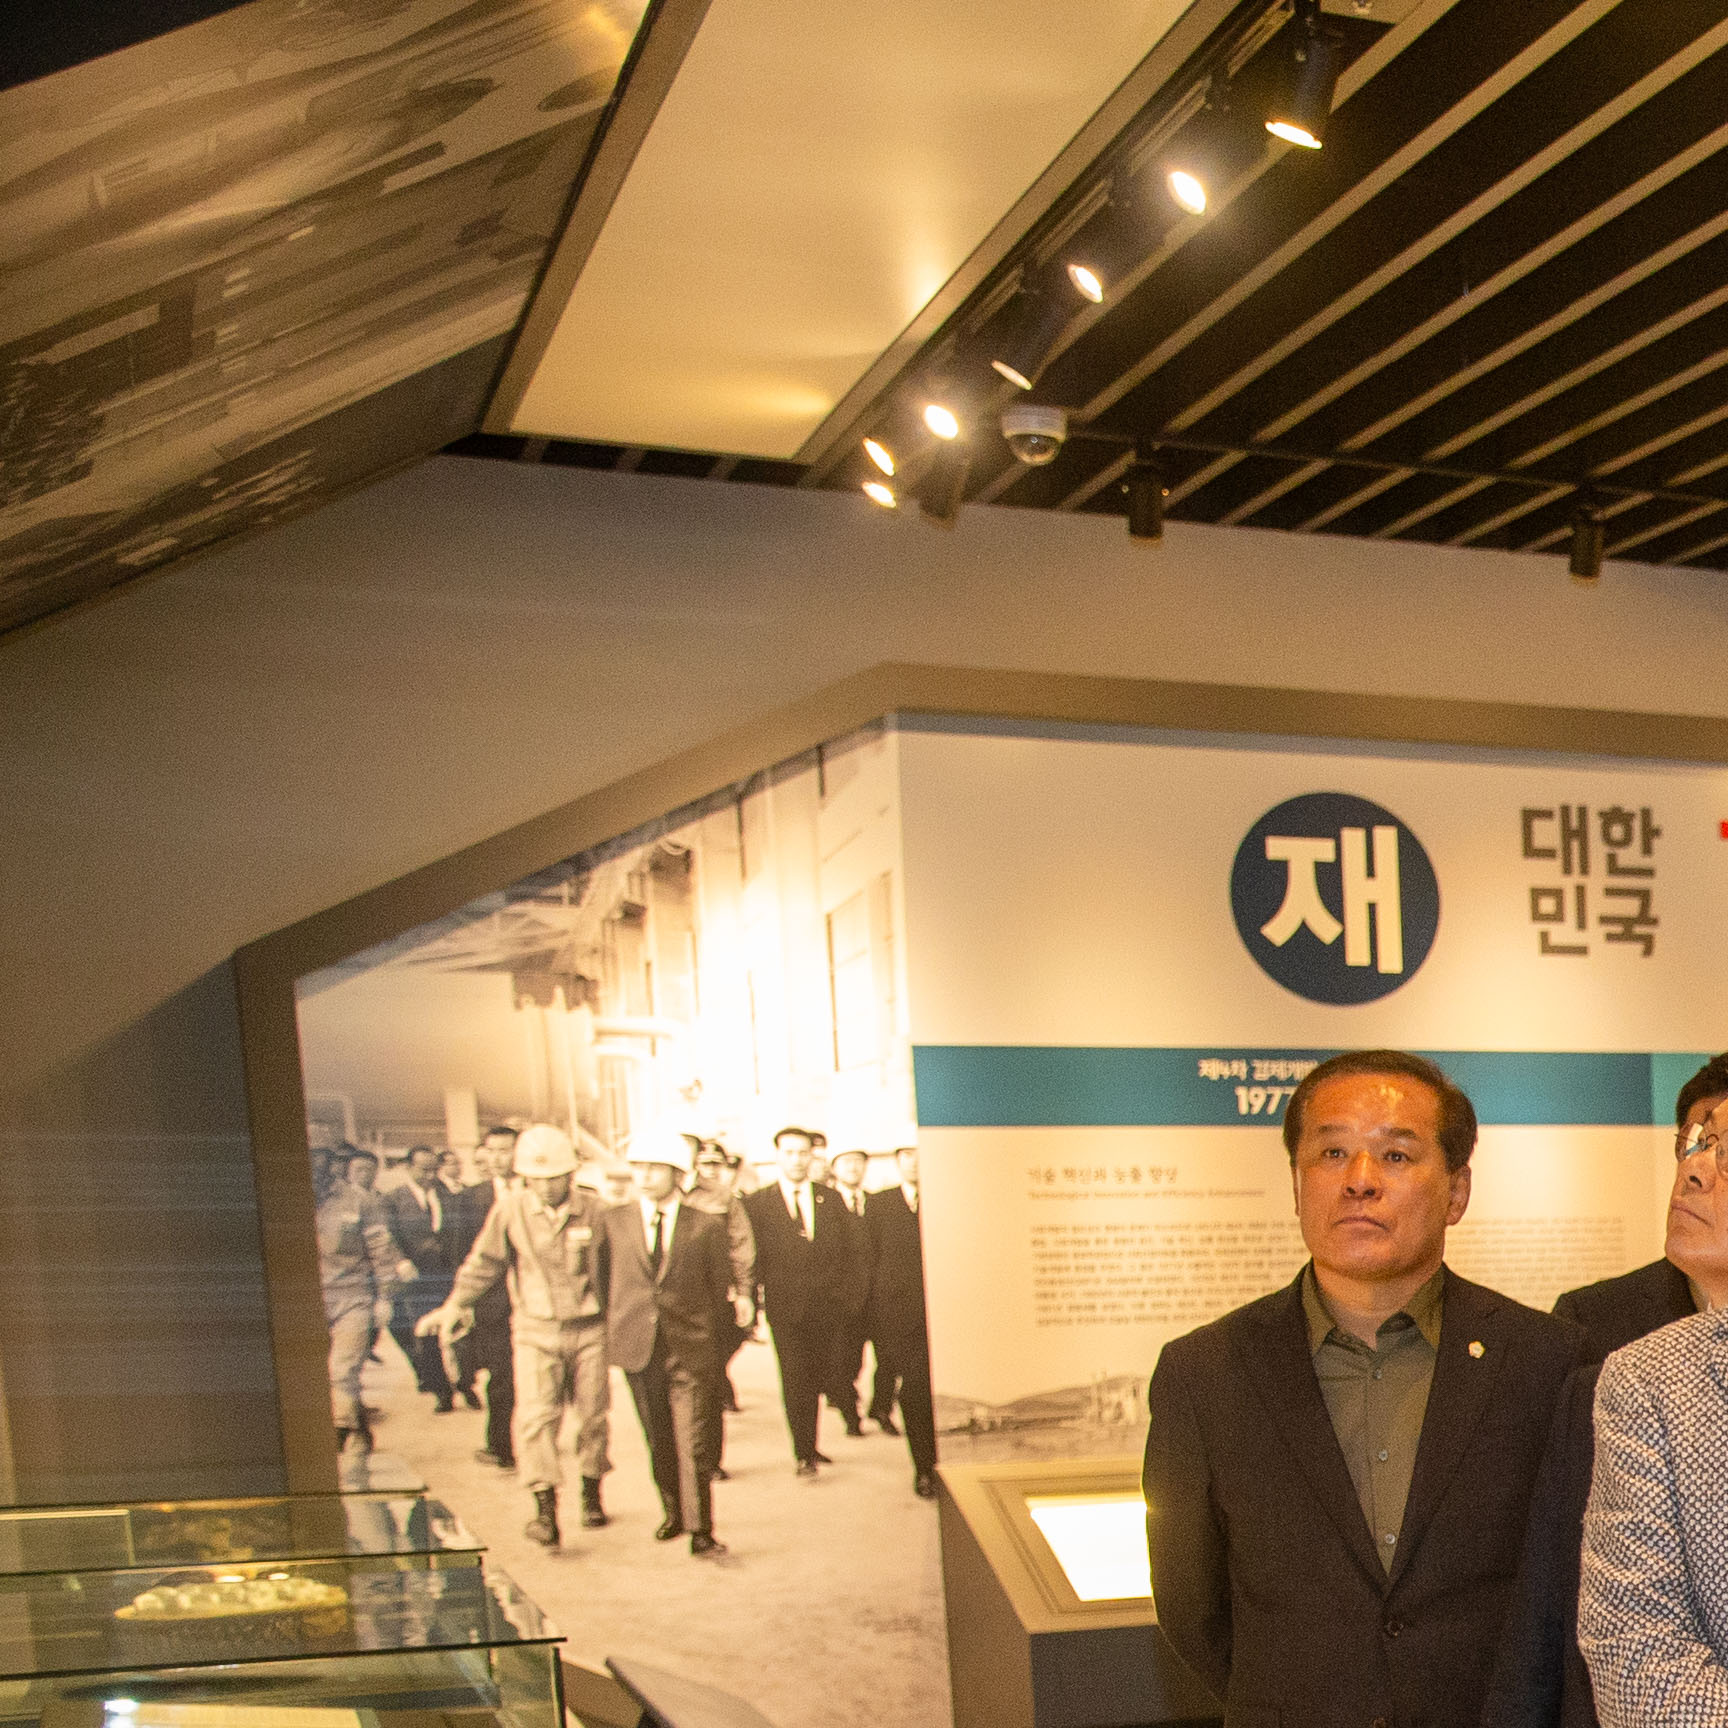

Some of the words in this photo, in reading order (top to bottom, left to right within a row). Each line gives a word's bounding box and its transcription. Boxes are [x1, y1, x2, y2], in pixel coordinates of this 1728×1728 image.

[1519, 804, 1662, 878] 대한
[1259, 824, 1403, 975] 재
[1529, 883, 1660, 958] 민국
